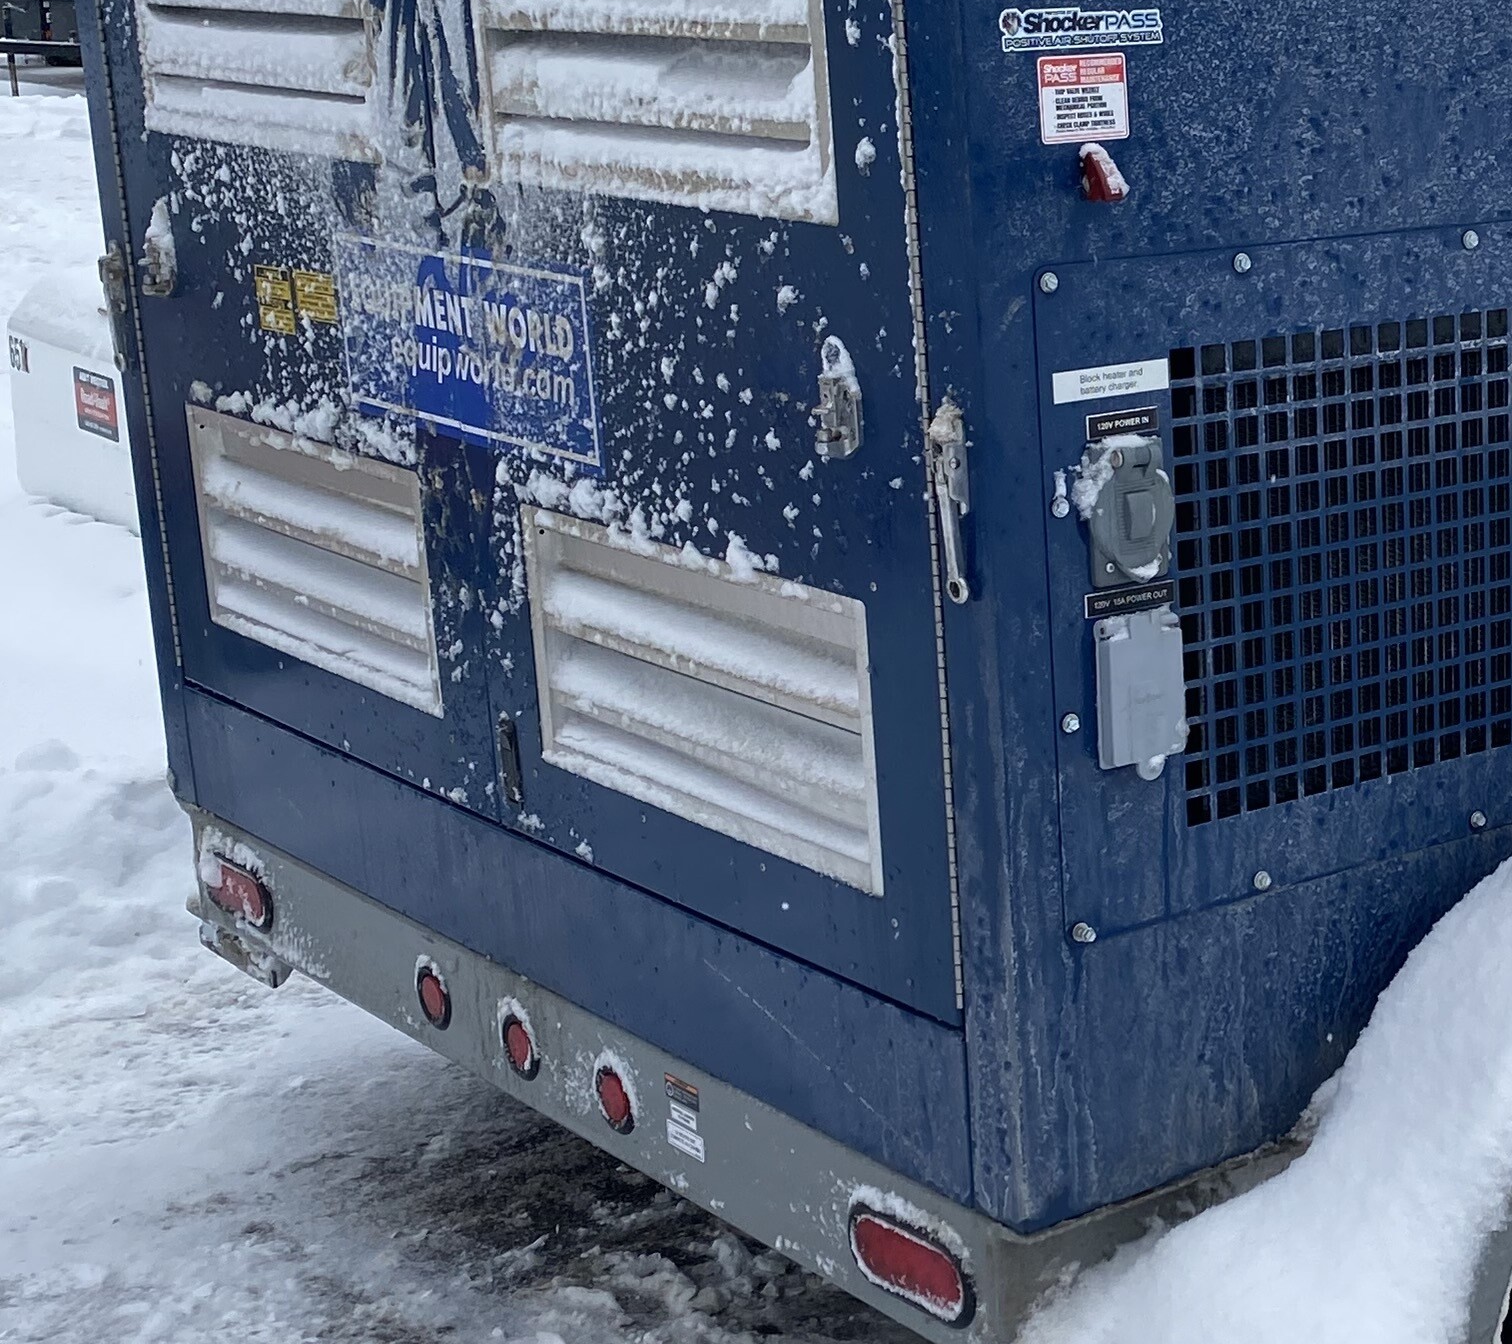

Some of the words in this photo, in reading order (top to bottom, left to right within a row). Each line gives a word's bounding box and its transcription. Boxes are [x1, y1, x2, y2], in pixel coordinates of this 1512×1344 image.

[1004, 34, 1052, 49] POSITIVE
[1053, 34, 1071, 46] AIR
[1073, 32, 1118, 45] SHUTOFF
[1119, 30, 1161, 42] SYSTEM
[1044, 73, 1078, 84] PASS
[484, 301, 575, 362] WORLD
[1079, 373, 1101, 384] Block
[1102, 370, 1127, 381] heater
[1128, 367, 1144, 378] and
[1080, 385, 1107, 396] battery
[1096, 420, 1115, 431] 120V
[1114, 417, 1141, 429] POWER
[1141, 415, 1150, 424] IN
[1126, 592, 1153, 605] POWER
[1152, 588, 1168, 599] OUT
